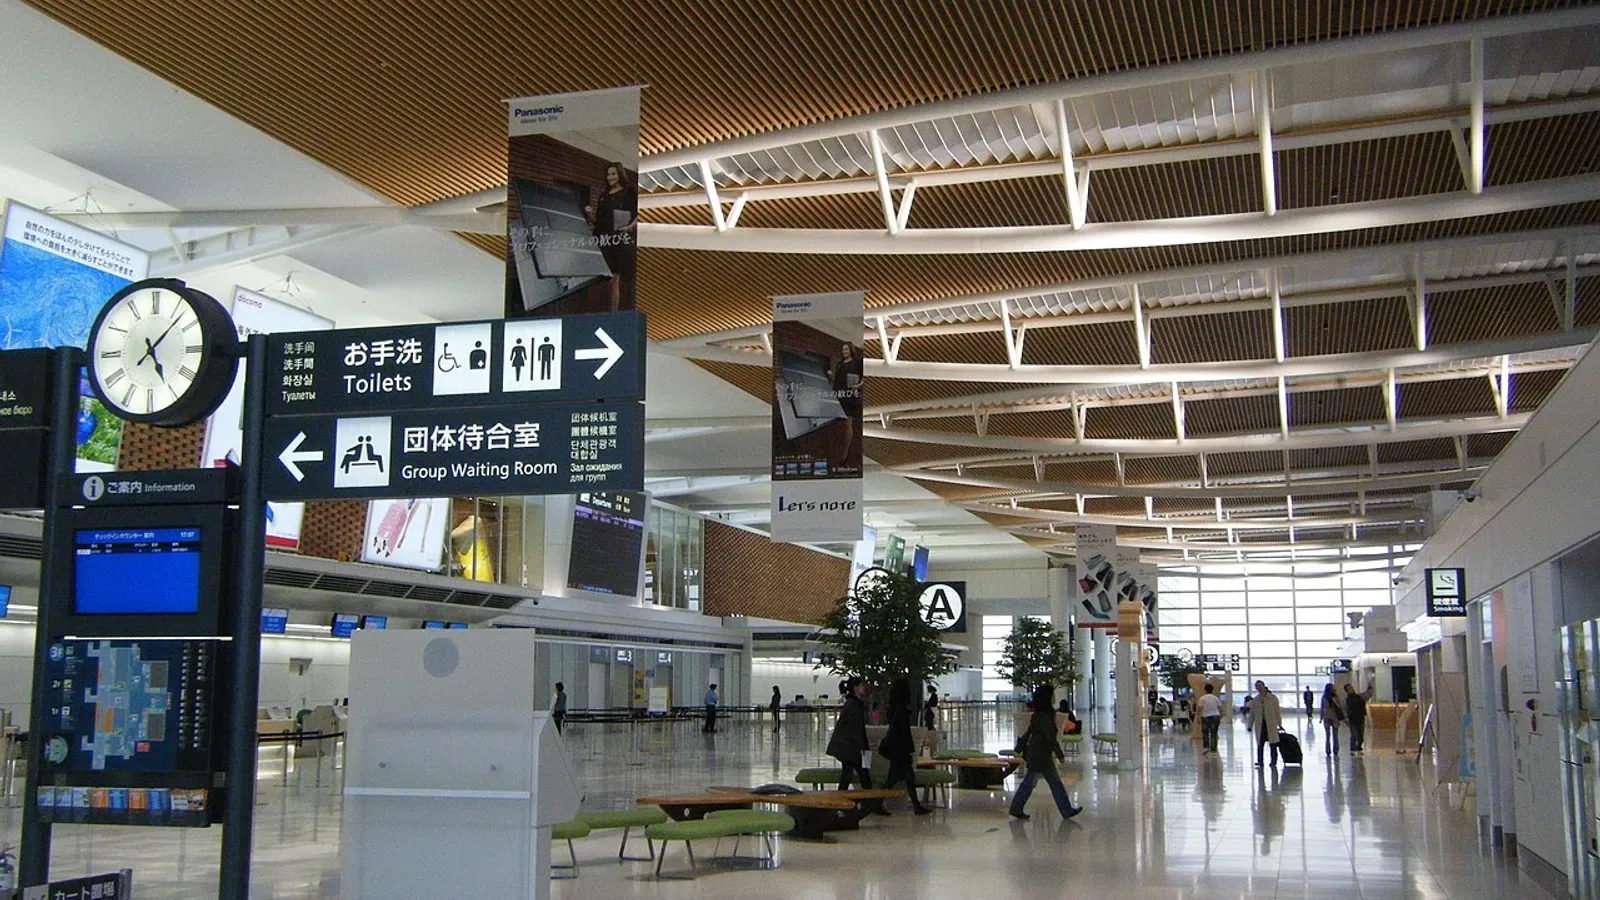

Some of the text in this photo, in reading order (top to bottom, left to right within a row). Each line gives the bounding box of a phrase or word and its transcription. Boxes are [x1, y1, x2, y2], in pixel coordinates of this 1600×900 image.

[515, 104, 564, 117] Panasonic
[238, 295, 263, 308] docomo
[776, 301, 811, 309] Panasonic
[283, 341, 315, 355] 洗手间
[343, 338, 423, 367] お手洗
[283, 357, 314, 371] 洗手間
[282, 374, 314, 387] 화장실
[343, 372, 412, 394] Toilets
[282, 391, 317, 403] Туалеты
[571, 411, 618, 424] 团体候机室
[403, 422, 541, 453] 団体待合室
[402, 460, 559, 482] Group Waiting Room
[570, 463, 623, 473] Зал ожидания
[585, 473, 607, 484] групп
[108, 481, 142, 494] ご案内
[144, 482, 197, 493] Information
[779, 495, 856, 512] Let's note
[925, 588, 956, 620] A
[1433, 605, 1464, 613] Smoking
[50, 646, 63, 658] 3F
